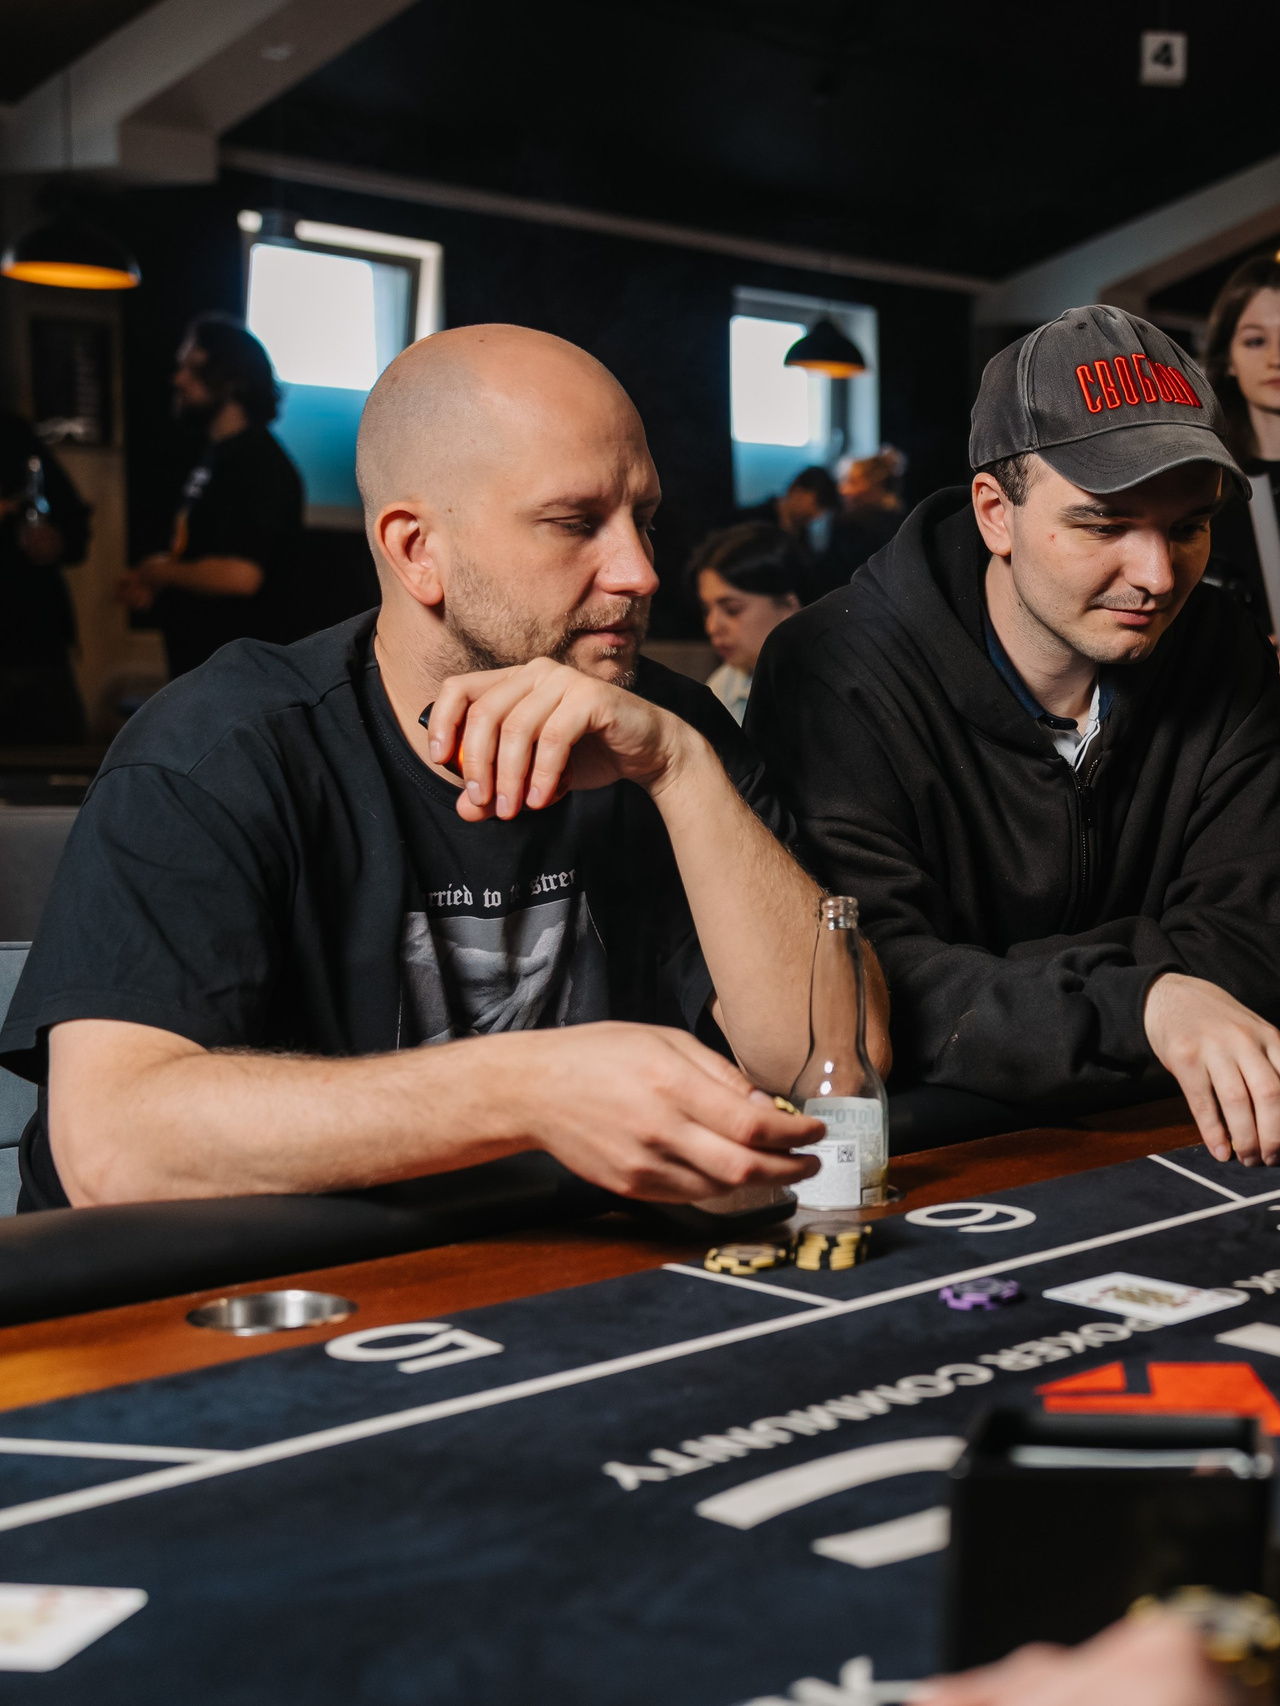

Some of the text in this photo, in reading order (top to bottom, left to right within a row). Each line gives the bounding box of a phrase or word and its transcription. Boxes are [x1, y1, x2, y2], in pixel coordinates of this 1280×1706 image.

[1150, 41, 1174, 69] 4
[1076, 353, 1203, 413] СВОБОД
[483, 888, 502, 908] to
[904, 1202, 1037, 1234] 6
[324, 1322, 504, 1374] 5
[602, 1363, 994, 1491] COMMUNITY
